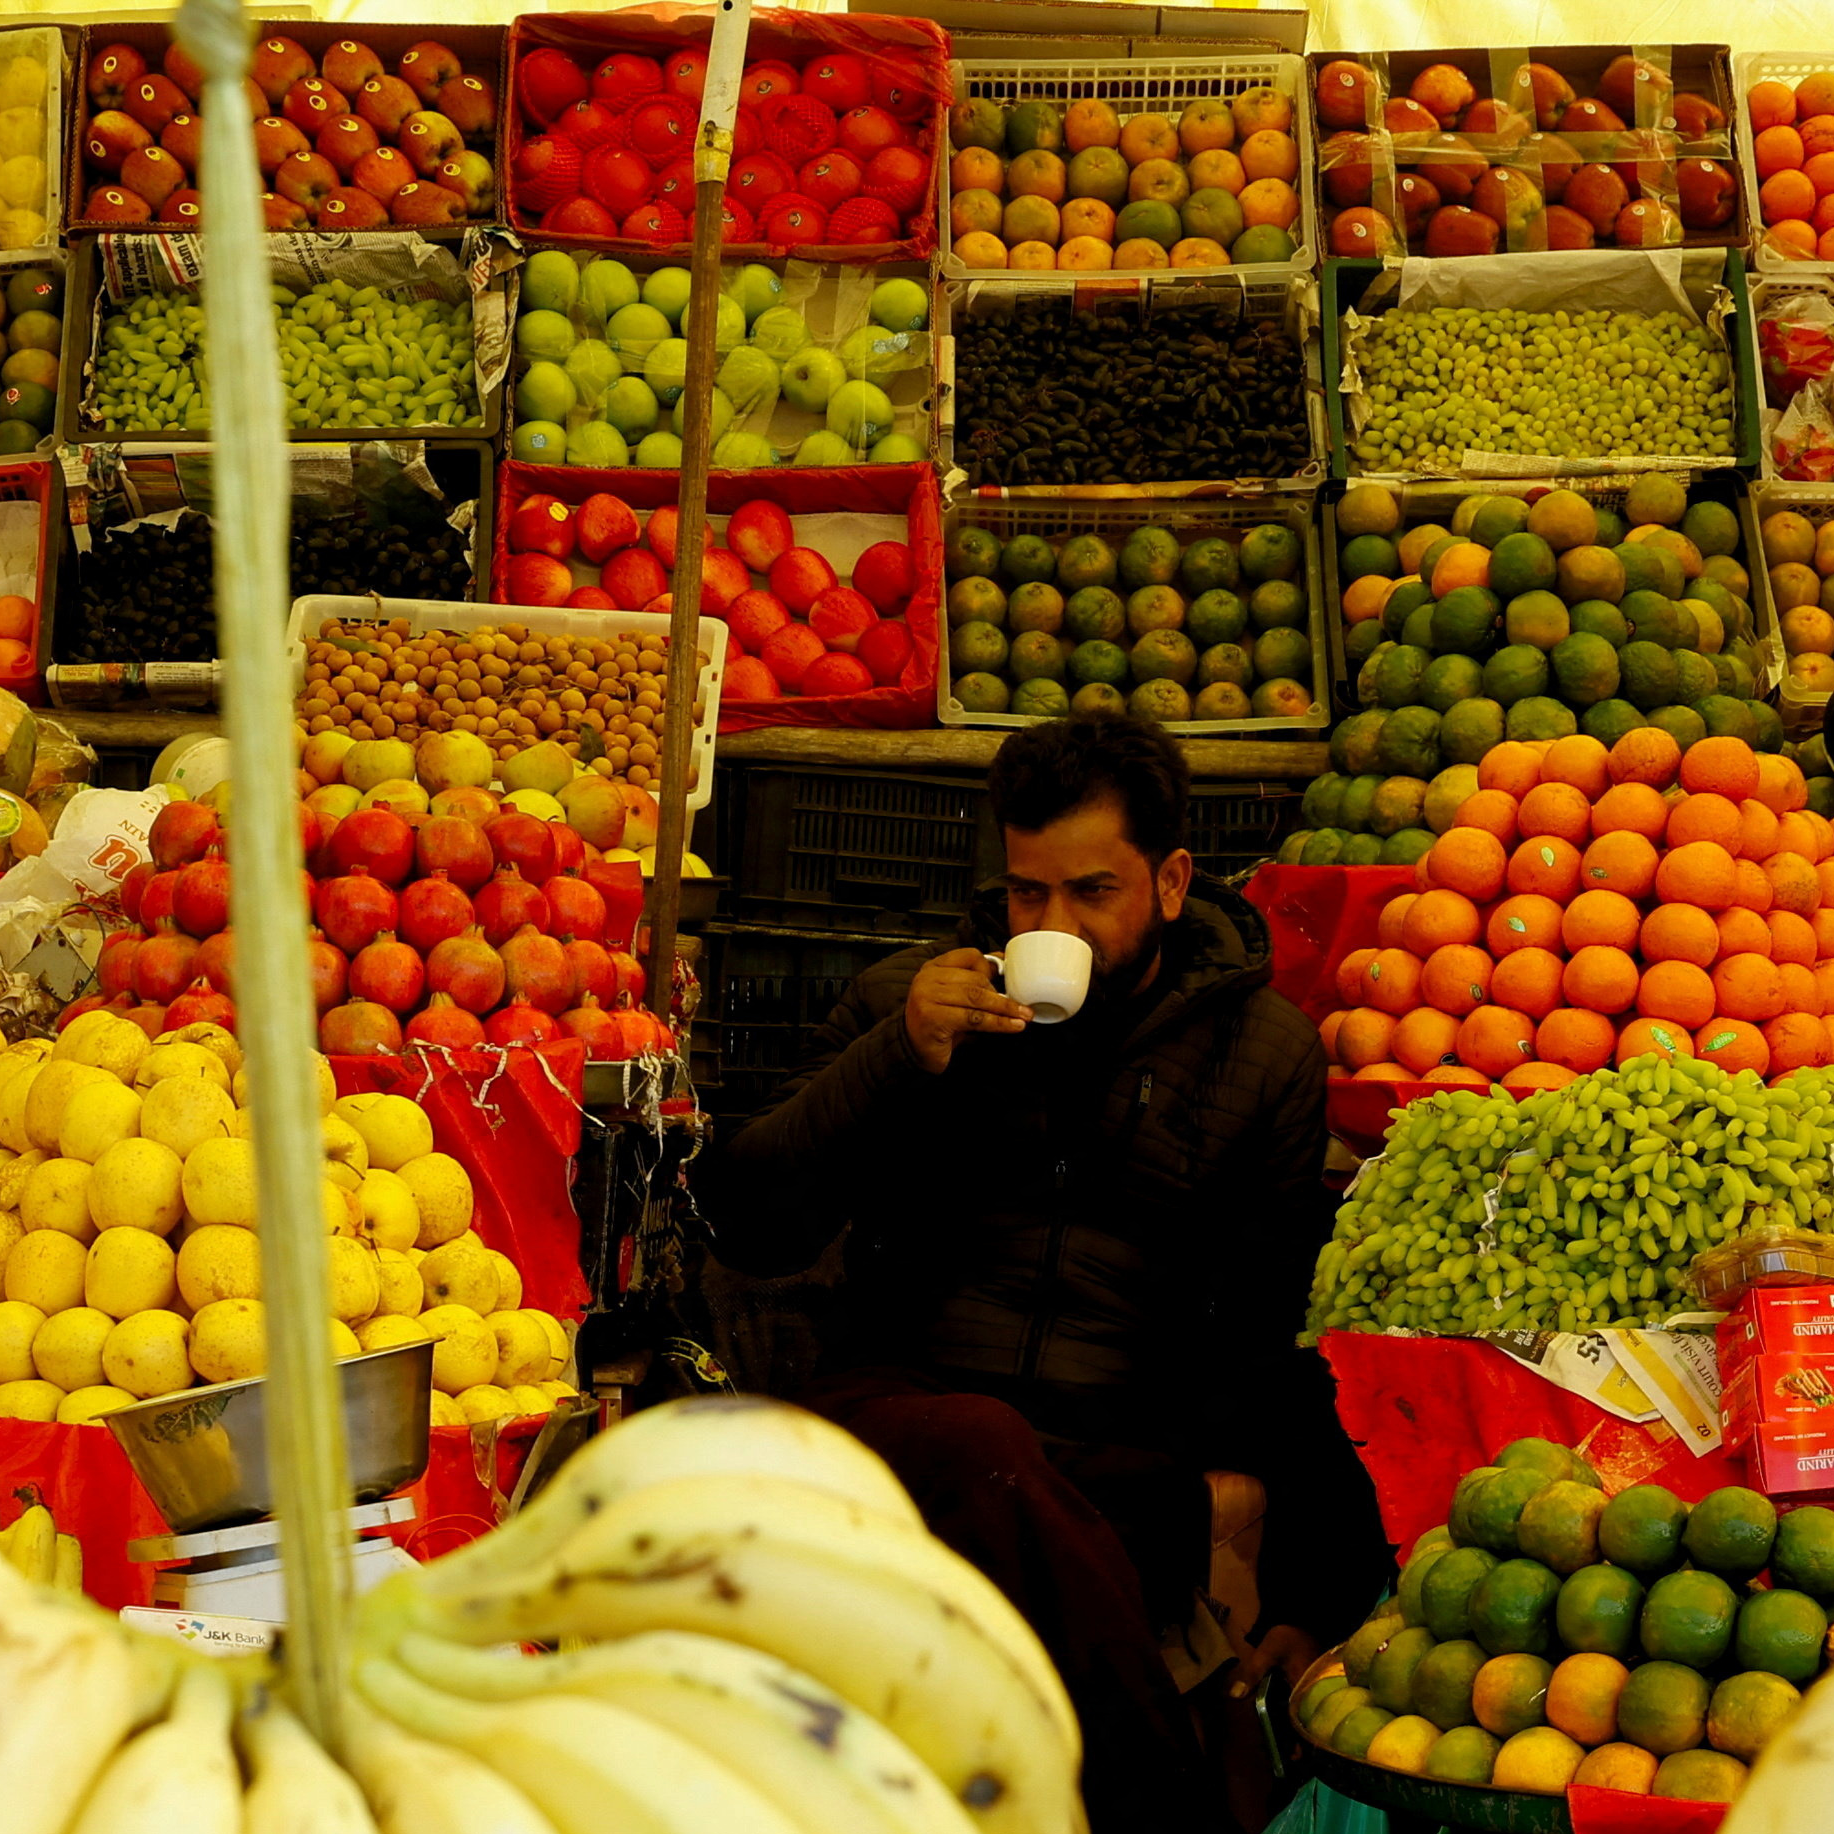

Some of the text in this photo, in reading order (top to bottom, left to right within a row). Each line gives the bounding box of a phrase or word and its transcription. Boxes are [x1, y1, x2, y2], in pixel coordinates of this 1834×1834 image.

[177, 243, 198, 276] exam
[117, 819, 149, 842] AIN
[1678, 1340, 1702, 1368] visit
[1696, 1364, 1723, 1398] court
[1695, 1421, 1711, 1438] 02
[203, 1628, 266, 1646] J&K Bank
